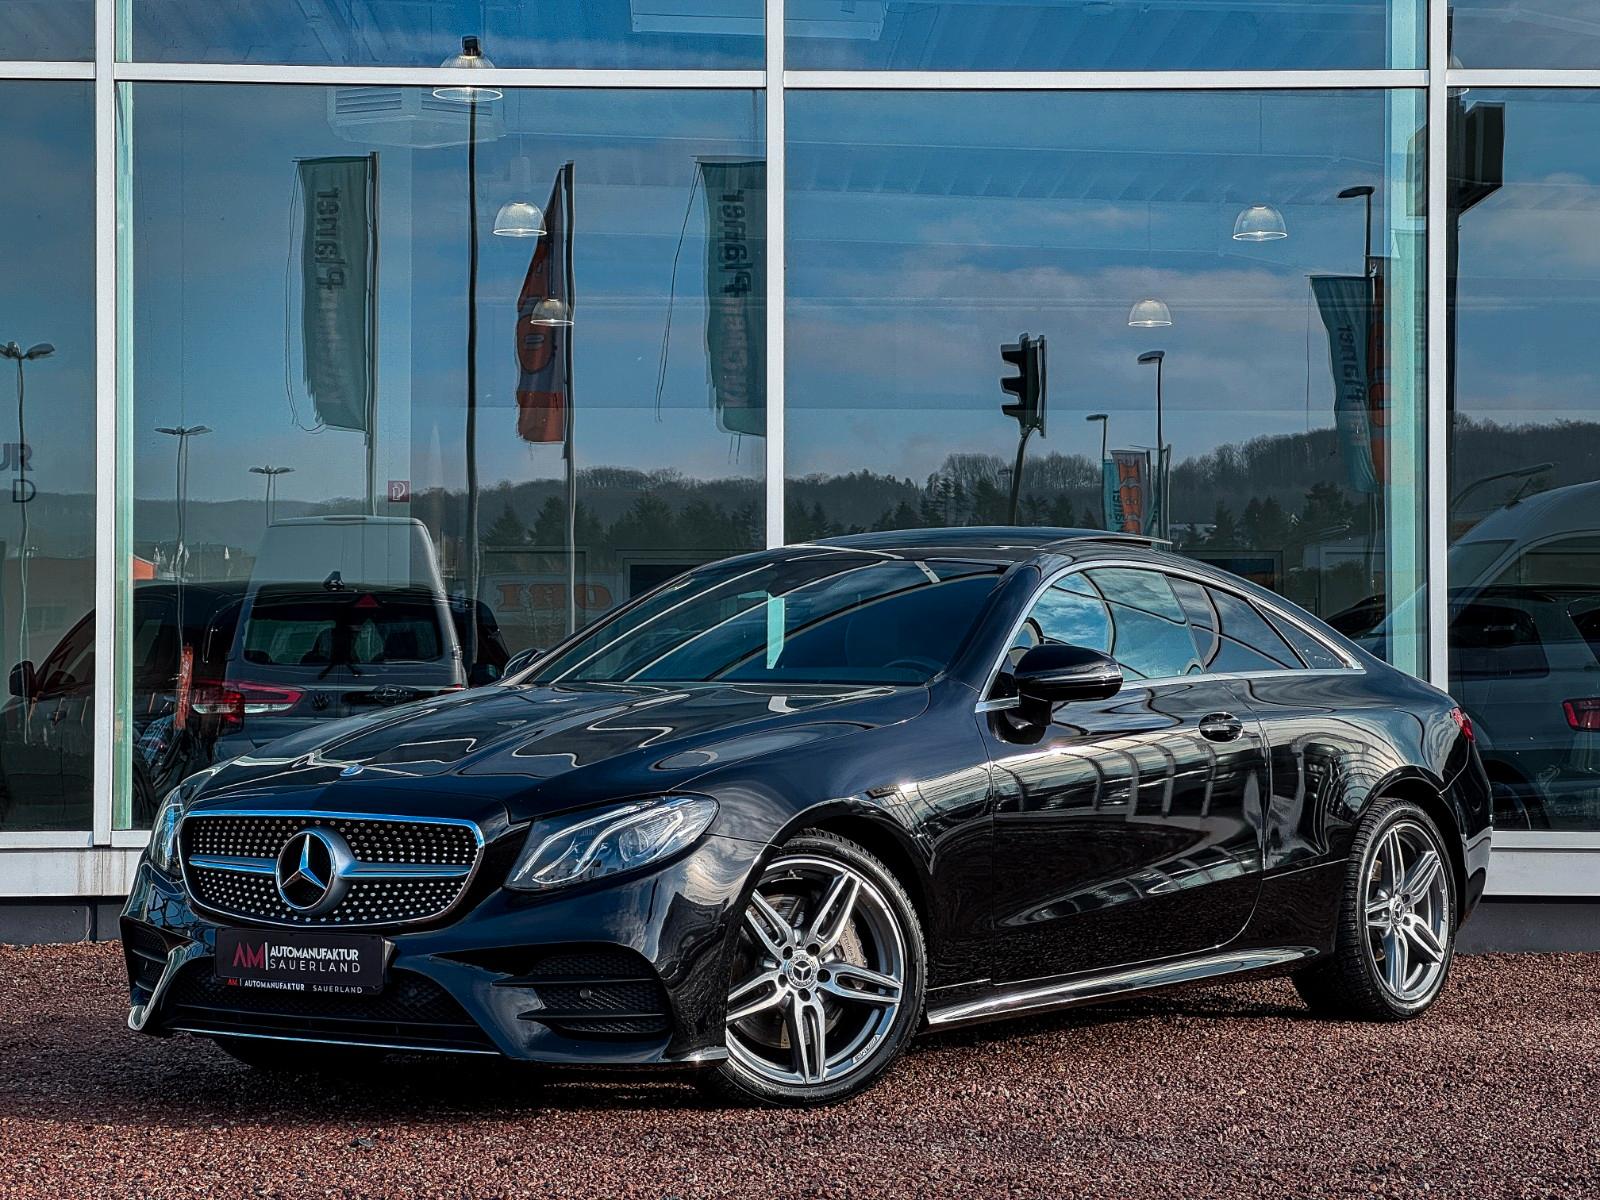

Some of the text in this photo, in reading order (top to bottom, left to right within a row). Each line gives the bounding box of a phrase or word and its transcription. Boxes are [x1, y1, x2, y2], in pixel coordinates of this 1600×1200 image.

[270, 945, 359, 962] AUTOMANUFAKTUR
[270, 958, 361, 973] SAUERLAND
[244, 979, 305, 991] AUTOMANUFAKTUR
[312, 984, 363, 994] SAUERLAND
